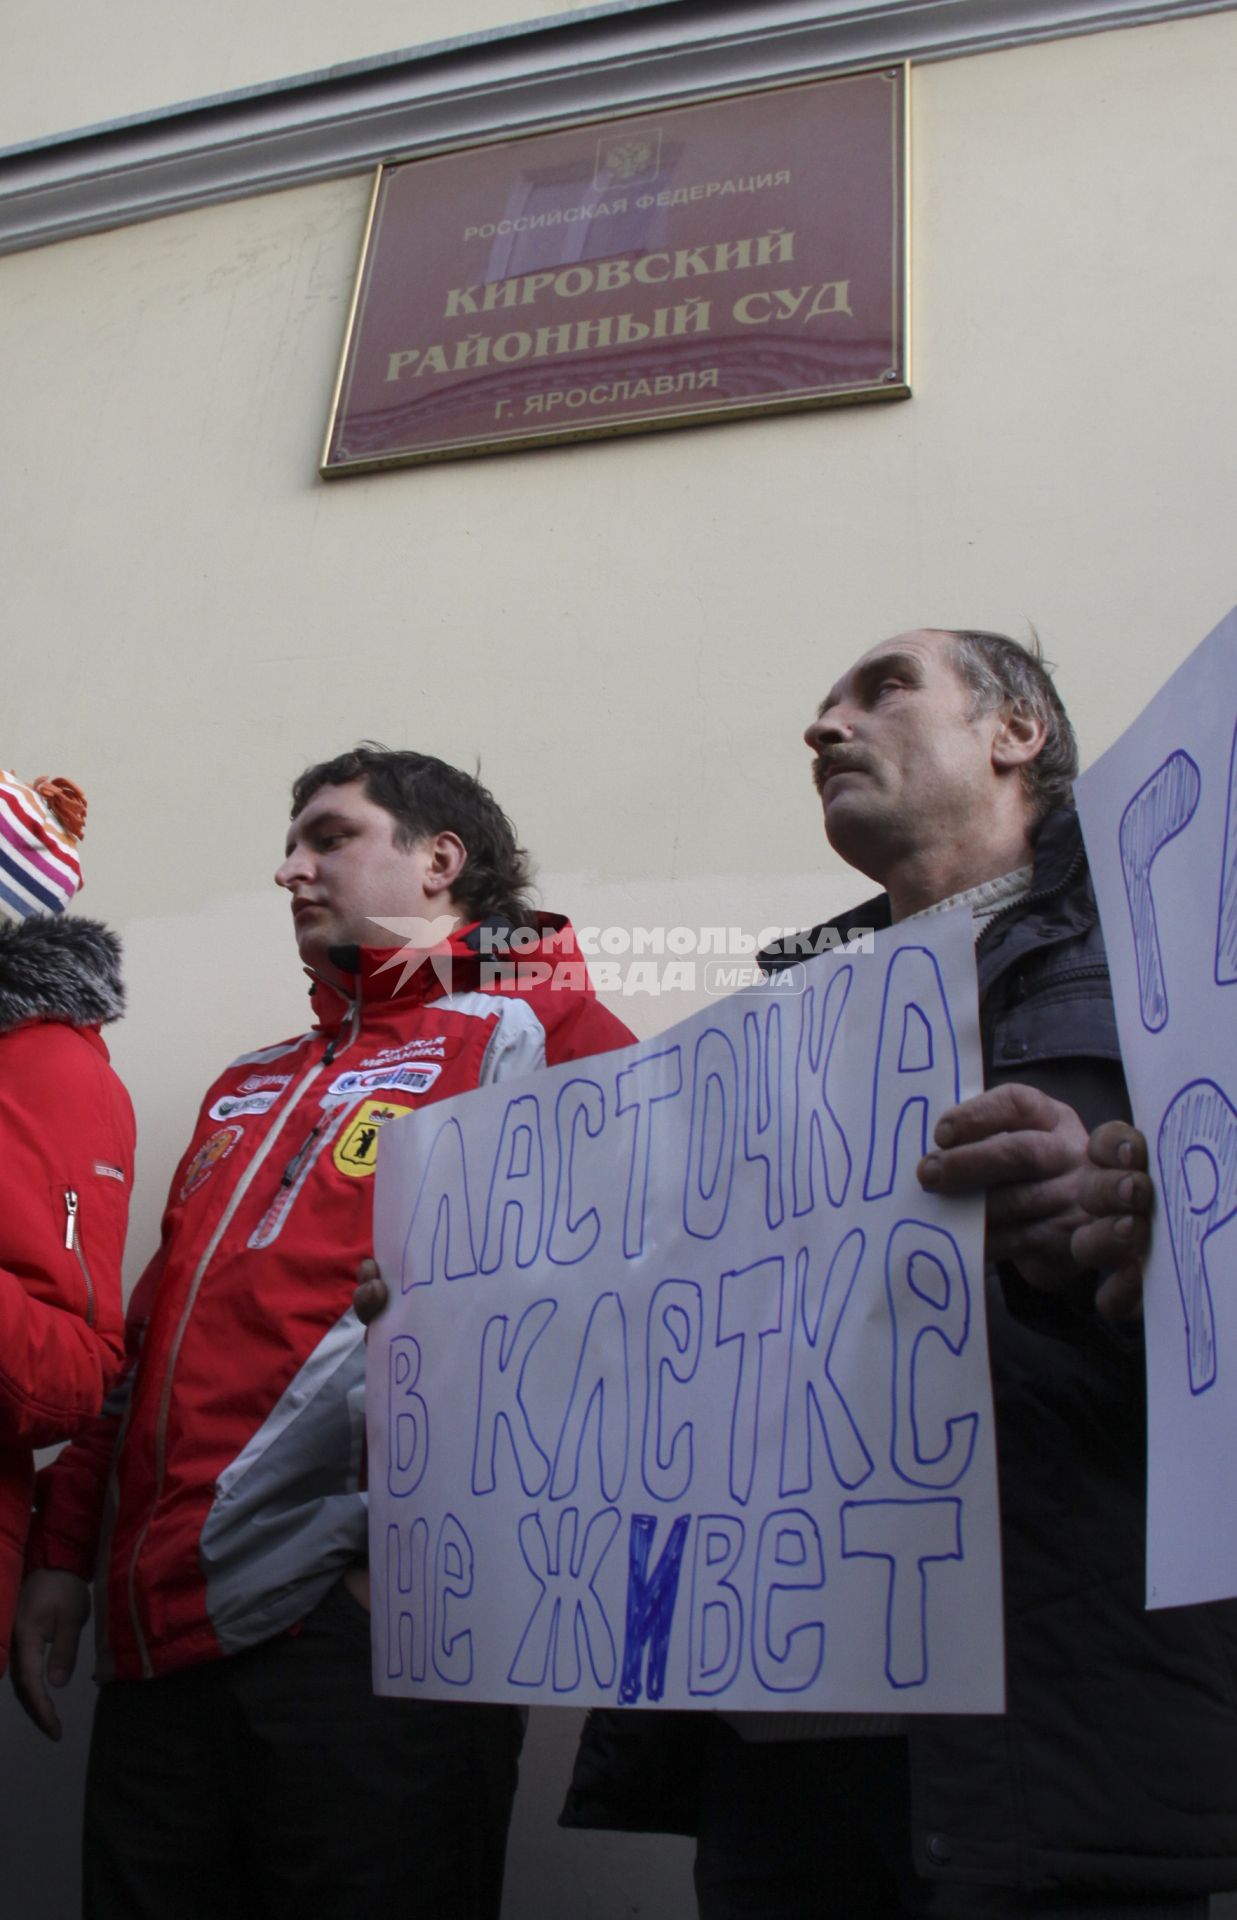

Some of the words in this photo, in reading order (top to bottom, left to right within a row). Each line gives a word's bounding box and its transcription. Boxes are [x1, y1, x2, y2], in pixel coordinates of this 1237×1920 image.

[464, 199, 628, 242] РОССИЙСКАЯ
[635, 169, 792, 210] ФЕДЕРАЦИЯ
[443, 227, 796, 318] КИРОВСКИЙ
[385, 297, 711, 382] РАЙОННЫЙ
[732, 279, 853, 327] СУД
[493, 398, 515, 419] Г.
[522, 367, 720, 416] ЯРОСЛАВЛЯ
[401, 946, 961, 1294] ЛАСТОЧКА
[387, 1335, 429, 1498] В
